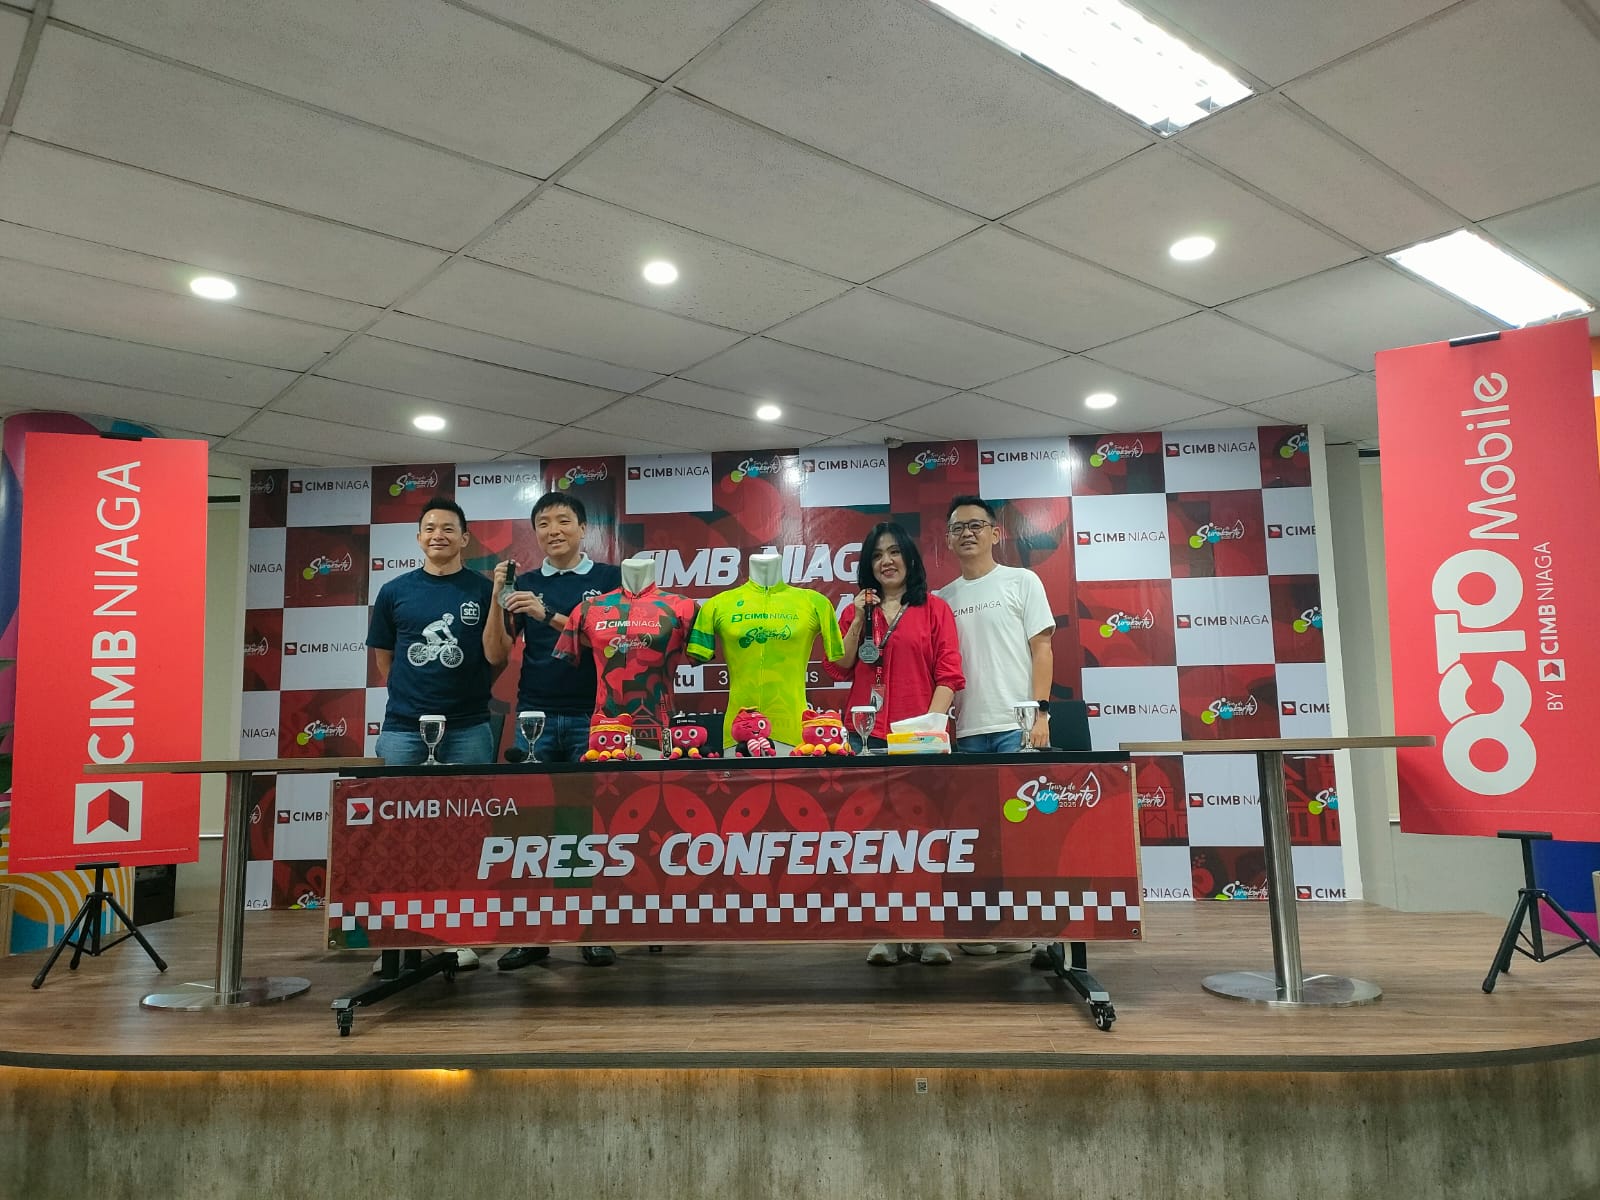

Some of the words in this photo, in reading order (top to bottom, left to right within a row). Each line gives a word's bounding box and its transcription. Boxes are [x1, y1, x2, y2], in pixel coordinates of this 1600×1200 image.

[1183, 444, 1215, 454] CIMB
[1217, 442, 1257, 453] NIAGA
[997, 452, 1028, 462] CIMB
[1460, 372, 1520, 541] Mobile
[818, 460, 848, 470] CIMB
[850, 458, 886, 469] NIAGA
[643, 468, 673, 478] CIMB
[674, 466, 710, 477] NIAGA
[305, 481, 334, 491] CIMB
[335, 480, 370, 490] NIAGA
[473, 475, 502, 485] CIMB
[503, 474, 538, 484] NIAGA
[93, 461, 141, 616] NIAGA
[1093, 533, 1126, 543] CIMB
[1128, 531, 1167, 542] NIAGA
[249, 563, 283, 573] NIAGA
[387, 559, 416, 569] CIMB
[1533, 541, 1558, 601] NIAGA
[463, 607, 478, 616] SCC
[975, 600, 1002, 612] NIAGA
[608, 620, 631, 628] CIMB
[631, 620, 662, 628] NIAGA
[1194, 616, 1227, 626] CIMB
[1230, 615, 1269, 626] NIAGA
[1538, 603, 1561, 655] CIMB
[299, 643, 329, 653] CIMB
[331, 641, 365, 653] NIAGA
[1431, 549, 1537, 796] OCTO
[87, 630, 137, 764] CIMB
[1547, 691, 1564, 711] BY
[1103, 705, 1136, 715] CIMB
[1138, 704, 1177, 715] NIAGA
[242, 728, 276, 738] NIAGA
[1016, 772, 1101, 811] Surakarta
[1206, 795, 1241, 805] CIMB
[379, 800, 441, 820] CIMB
[445, 797, 519, 818] NIAGA
[292, 811, 323, 822] CIMB
[476, 833, 640, 880] PRESS
[659, 828, 980, 876] CONFERENCE
[1150, 888, 1190, 899] NIAGA
[246, 899, 269, 908] AGA
